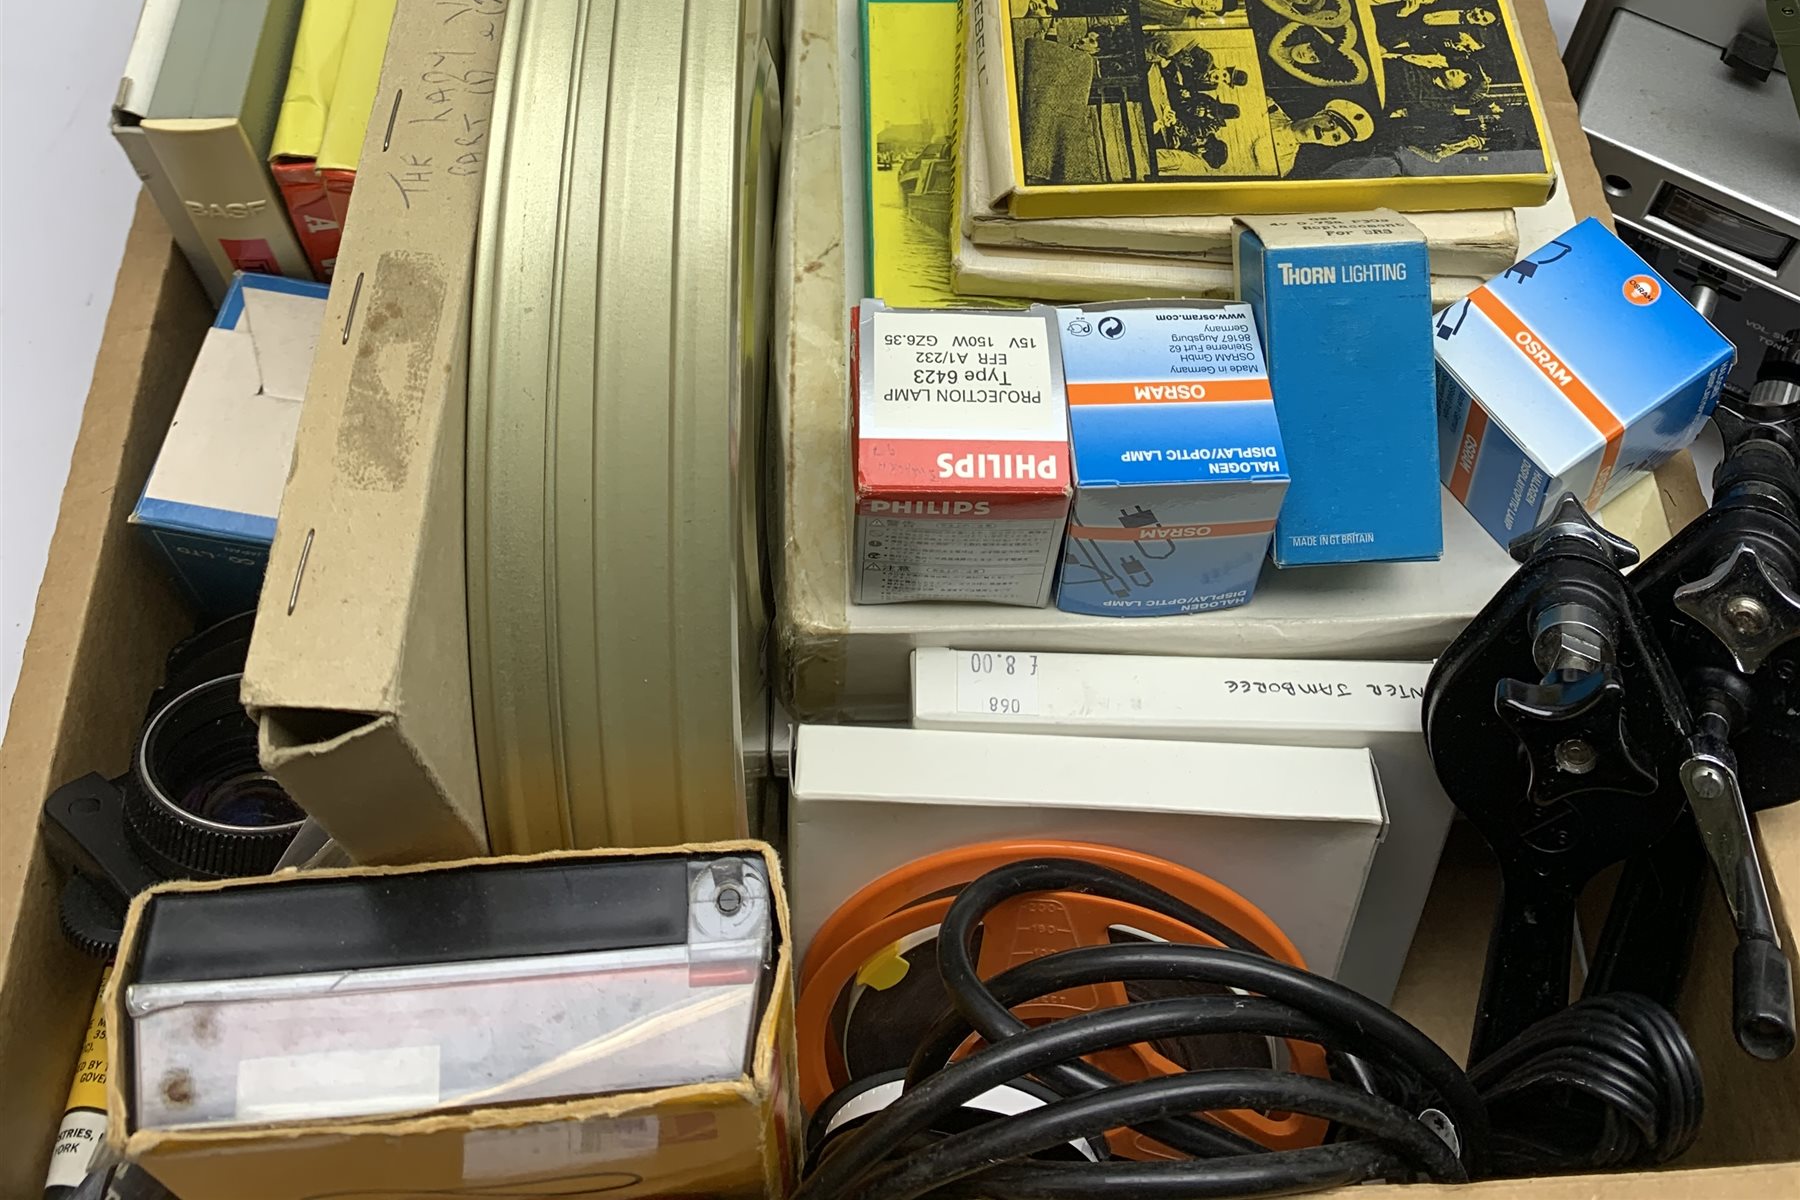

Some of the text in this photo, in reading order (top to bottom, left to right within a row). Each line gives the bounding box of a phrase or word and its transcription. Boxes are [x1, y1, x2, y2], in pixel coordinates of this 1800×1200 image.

[185, 200, 266, 218] BASF
[1277, 262, 1407, 286] THORN LIGHTING
[1629, 279, 1655, 303] OSRAM
[1155, 313, 1246, 322] www.osram.com
[1204, 324, 1249, 333] Germany
[884, 335, 1037, 349] 15V 150W GZ6.35
[1171, 334, 1251, 343] 86167 Augsburg
[1759, 336, 1789, 353] TONE
[1169, 343, 1253, 353] Steinerne Furt 62
[916, 352, 1008, 365] EFR A1/232
[1180, 352, 1255, 362] OSRAM GmbH
[1515, 331, 1573, 387] OSRAM
[1170, 364, 1258, 375] Made in Germany
[914, 370, 1012, 386] Type 6423
[884, 389, 1041, 404] PROJECTION LAMP
[1134, 385, 1206, 400] OSRAM
[1120, 447, 1276, 462] DISPLAY/OPTIC LAMP
[1460, 433, 1478, 474] OSRAM
[936, 453, 1057, 480] PHILIPS
[1209, 461, 1280, 474] HALOGEN
[1525, 470, 1543, 507] HALOGEN
[870, 501, 991, 515] PHILIPS
[1503, 509, 1516, 531] LAMP
[1139, 526, 1212, 539] OSRAM
[1292, 536, 1317, 547] MADE
[1320, 535, 1328, 545] IN
[1341, 532, 1375, 544] BRITAIN
[1102, 590, 1247, 608] DISPLAY/OPTIC LAMP
[1181, 598, 1245, 611] HALOGEN
[971, 653, 1016, 675] 8.00
[1225, 681, 1351, 696] JAMBOREE
[989, 697, 1020, 713] 068
[88, 1061, 103, 1071] BY
